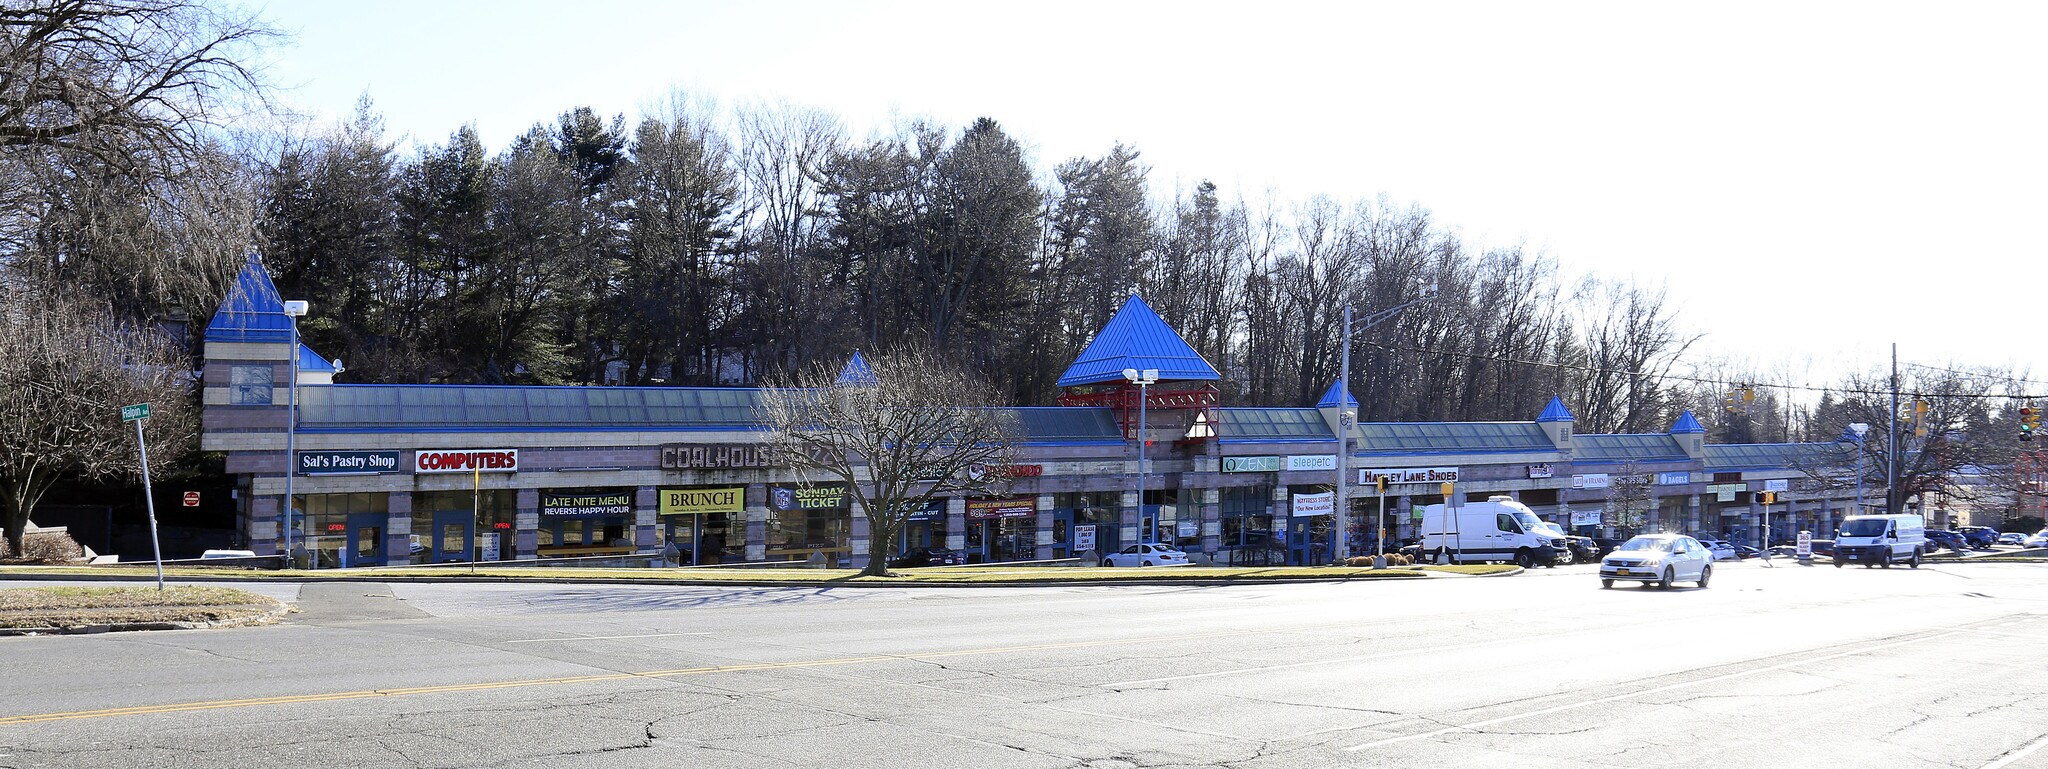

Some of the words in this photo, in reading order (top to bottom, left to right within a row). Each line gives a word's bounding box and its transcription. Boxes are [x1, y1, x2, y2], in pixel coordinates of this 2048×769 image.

[122, 406, 141, 419] Halpin
[303, 455, 330, 467] Sal's
[332, 455, 366, 469] Pastry
[368, 454, 395, 469] Shop
[418, 451, 516, 470] COMPUTERS
[1293, 458, 1331, 468] sleepetc
[1404, 470, 1426, 482] LANE
[1428, 469, 1457, 481] SHOES
[795, 487, 845, 498] SUNDAY
[545, 497, 571, 507] LATE
[573, 497, 597, 506] NITE
[598, 496, 629, 506] MENU
[670, 491, 735, 507] BRUNCH
[799, 497, 841, 508] TICKET
[544, 507, 577, 515] REVERSE
[578, 506, 606, 515] HAPPY
[606, 505, 630, 513] HOUR
